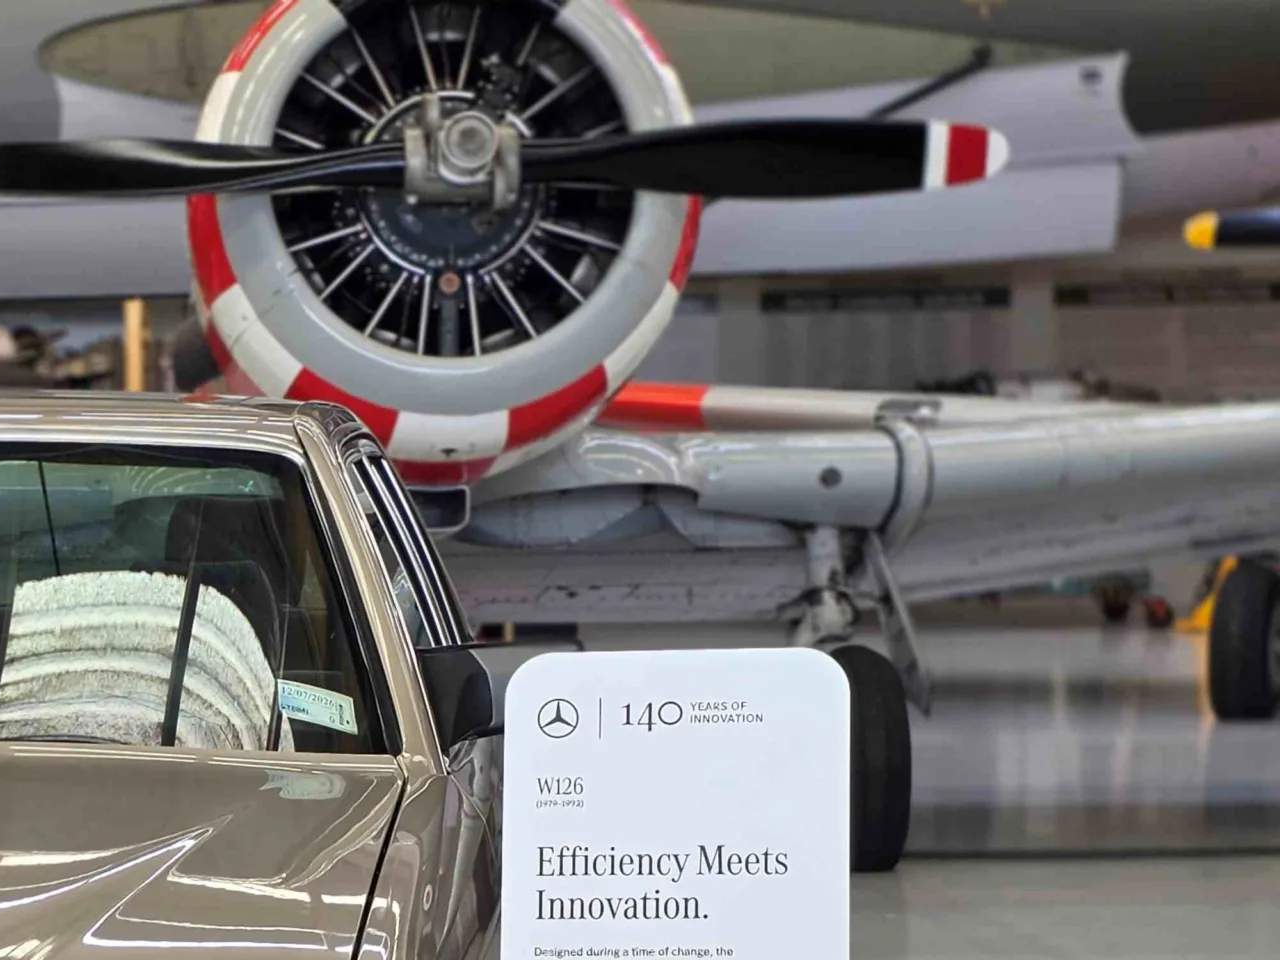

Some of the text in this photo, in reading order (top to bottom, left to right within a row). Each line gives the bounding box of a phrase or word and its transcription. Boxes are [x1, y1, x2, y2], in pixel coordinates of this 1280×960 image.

[620, 700, 684, 732] 140
[689, 701, 749, 712] YEARS OF
[689, 713, 764, 725] INNOVATION
[536, 776, 584, 796] W126
[535, 844, 789, 883] Efficiency Meets
[535, 889, 709, 921] Innovation.
[533, 946, 734, 959] Designed during a time of change, the
